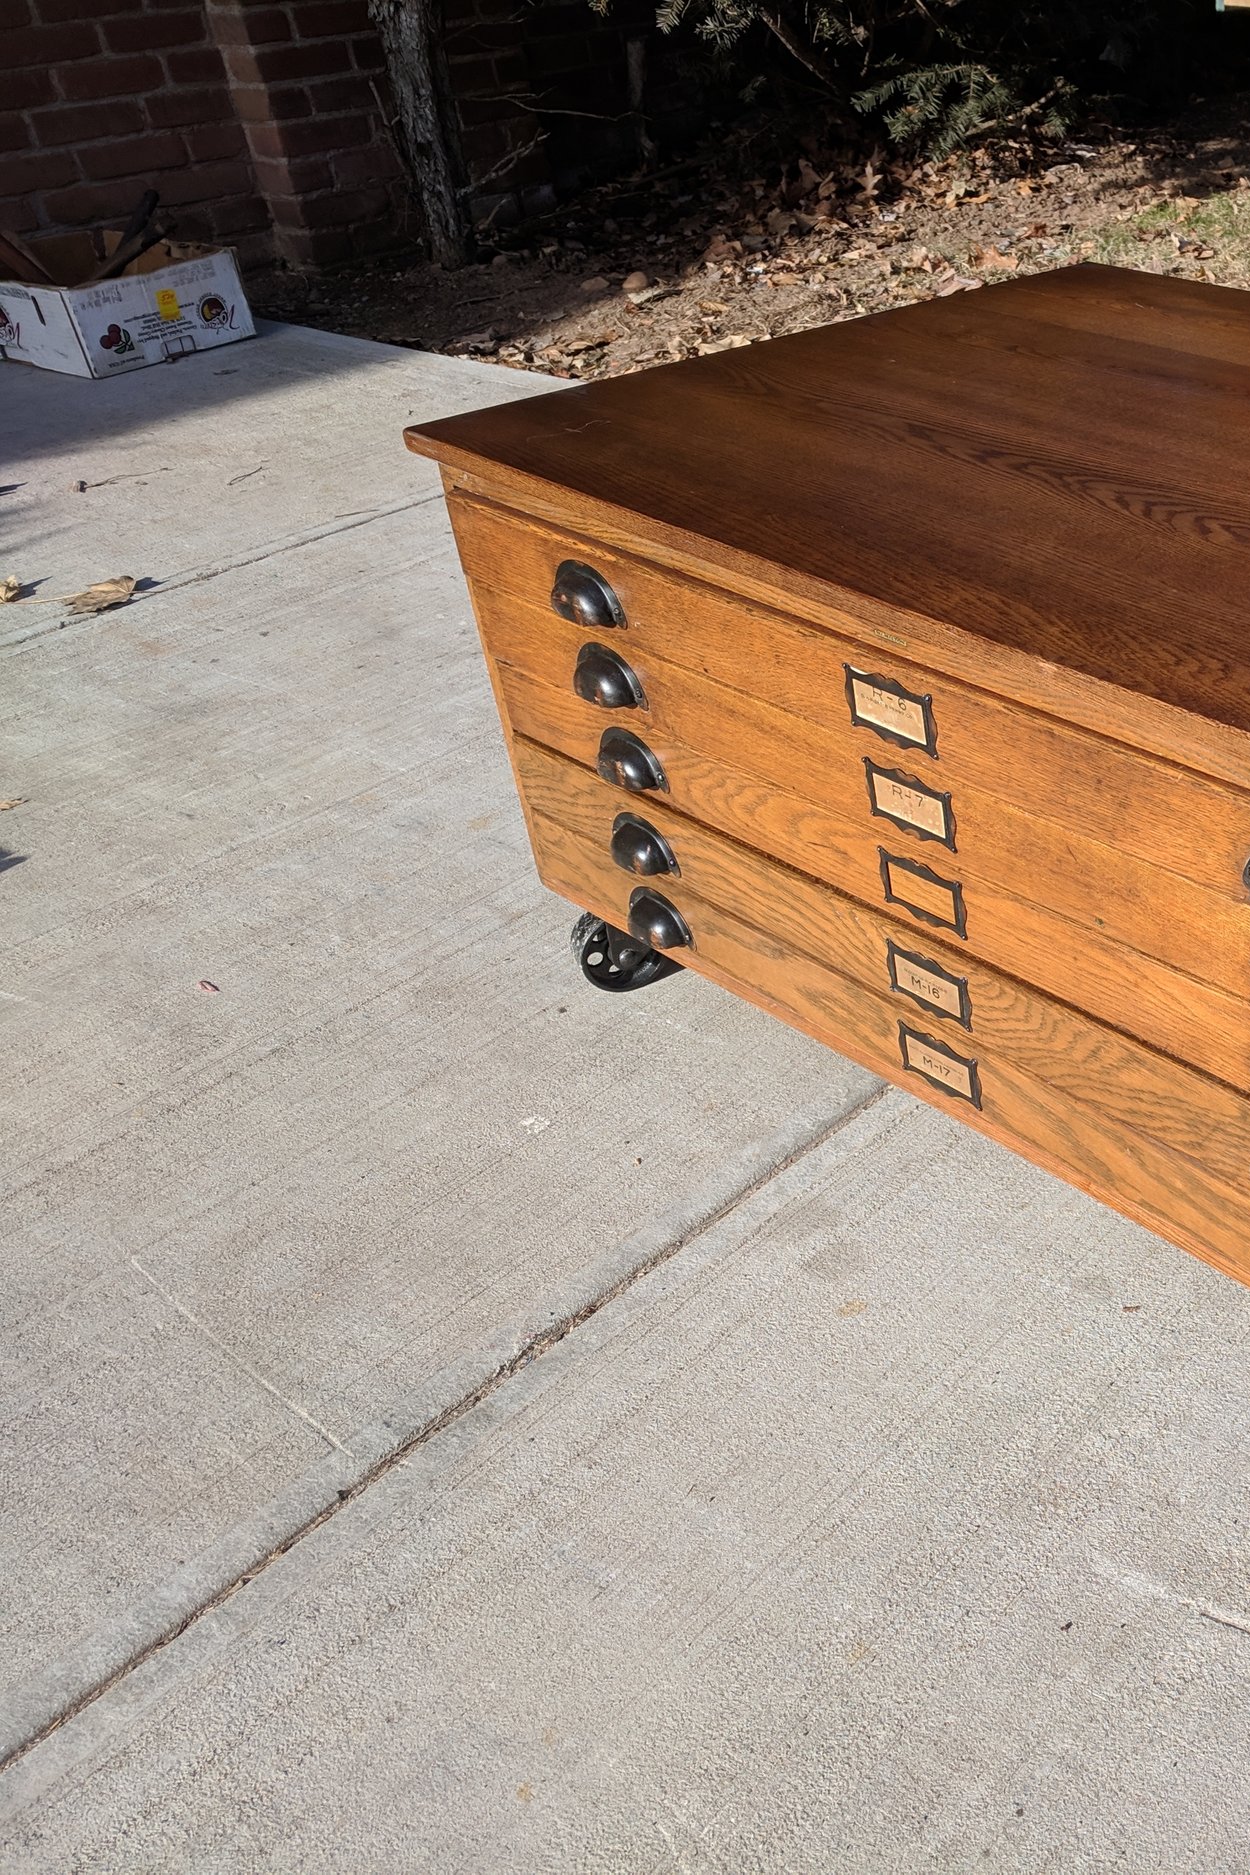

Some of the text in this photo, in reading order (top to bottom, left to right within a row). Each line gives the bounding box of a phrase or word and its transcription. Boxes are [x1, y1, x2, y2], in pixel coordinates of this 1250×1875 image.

[872, 687, 907, 711] R-6
[891, 784, 924, 807] R-7
[911, 976, 940, 999] M-16
[922, 1056, 951, 1077] M-17
